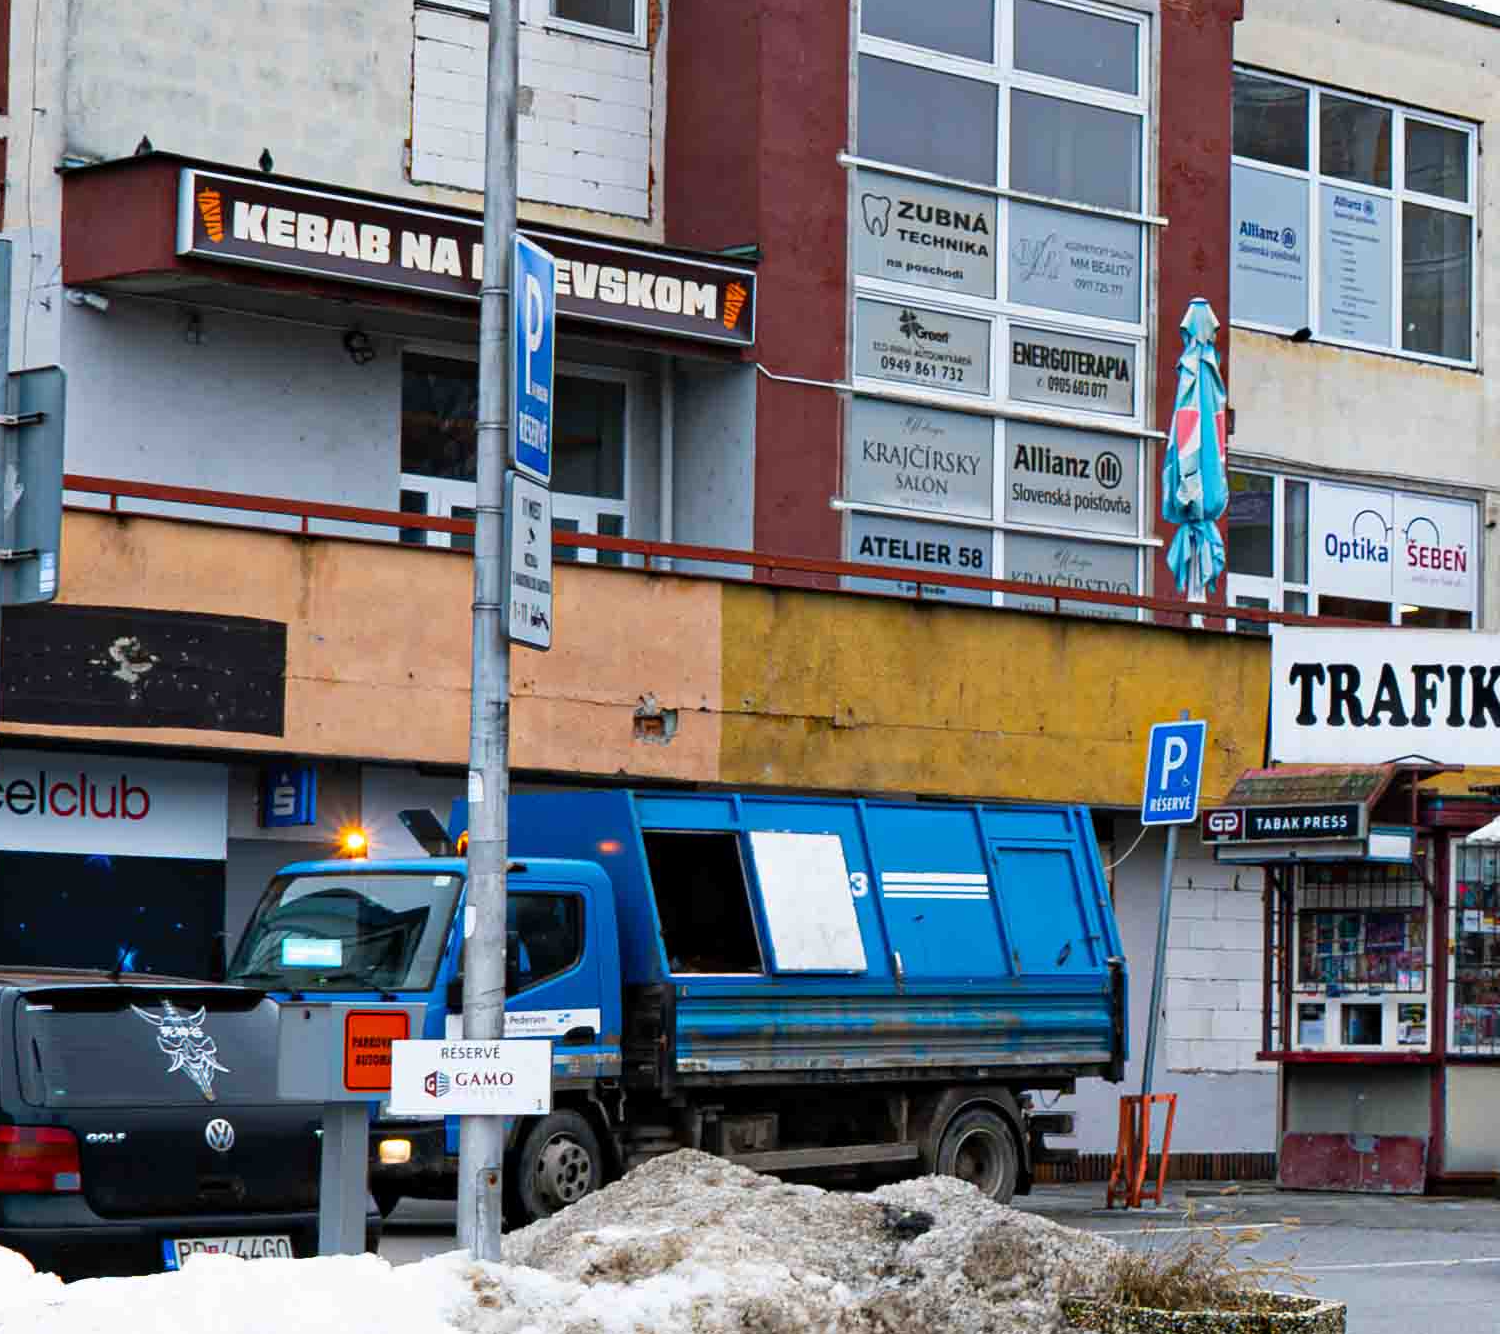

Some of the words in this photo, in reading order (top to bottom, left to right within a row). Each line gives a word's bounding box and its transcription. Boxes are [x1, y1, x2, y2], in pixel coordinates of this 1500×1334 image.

[898, 201, 988, 235] ZUBNÁ
[897, 229, 988, 257] TECHNIKA
[1239, 221, 1279, 242] Allianz
[233, 201, 390, 264] KEBAB
[401, 230, 462, 279] NA
[474, 244, 717, 319] EVSKOM
[887, 259, 902, 269] na
[1071, 257, 1090, 269] MM
[1092, 261, 1133, 277] BEAUTY
[524, 274, 544, 395] P
[881, 356, 911, 373] 0949
[916, 360, 937, 378] 861
[943, 364, 964, 382] 732
[1013, 341, 1130, 382] ENERGOTERAPIA
[1048, 376, 1071, 394] 0905
[1014, 444, 1090, 479] Allianz
[1012, 482, 1071, 508] Slovenská
[1074, 492, 1132, 515] poisťovňa
[860, 535, 951, 566] ATELIER
[959, 546, 983, 569] 58
[1325, 534, 1389, 563] Optika
[1407, 540, 1467, 573] ŠEBEŇ
[1160, 736, 1188, 791] P
[1150, 794, 1192, 812] RÉSERVÉ
[1256, 817, 1300, 831] TABAK
[1303, 815, 1348, 829] PRESS
[850, 872, 868, 897] 3
[441, 1043, 501, 1059] RÉSERVÉ
[455, 1072, 514, 1087] GAMO
[535, 1099, 543, 1110] 1
[86, 1132, 126, 1144] GOLF
